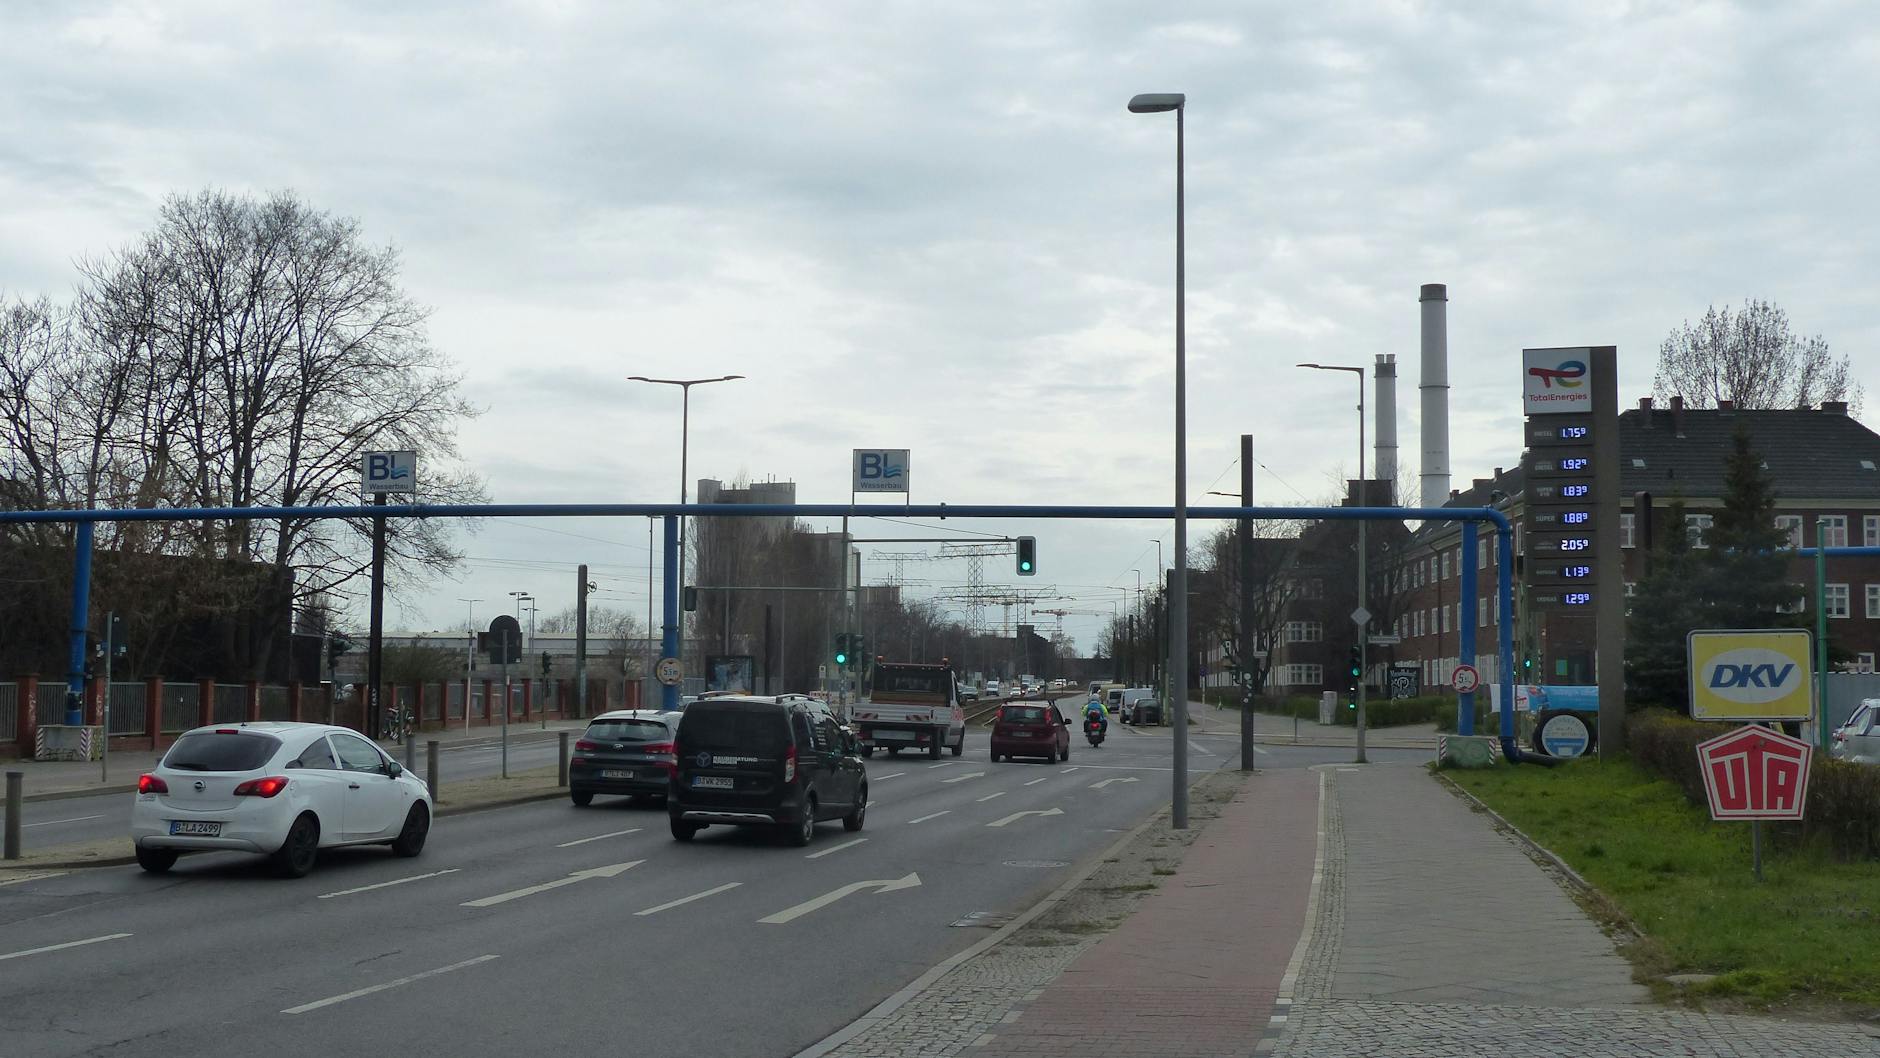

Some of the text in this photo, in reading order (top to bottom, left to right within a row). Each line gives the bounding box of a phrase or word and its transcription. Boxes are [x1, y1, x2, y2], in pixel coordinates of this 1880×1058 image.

[1528, 393, 1588, 403] TotalEnergies
[860, 481, 902, 489] Wasserbau
[1709, 663, 1795, 688] DKV
[1709, 734, 1801, 810] UTA
